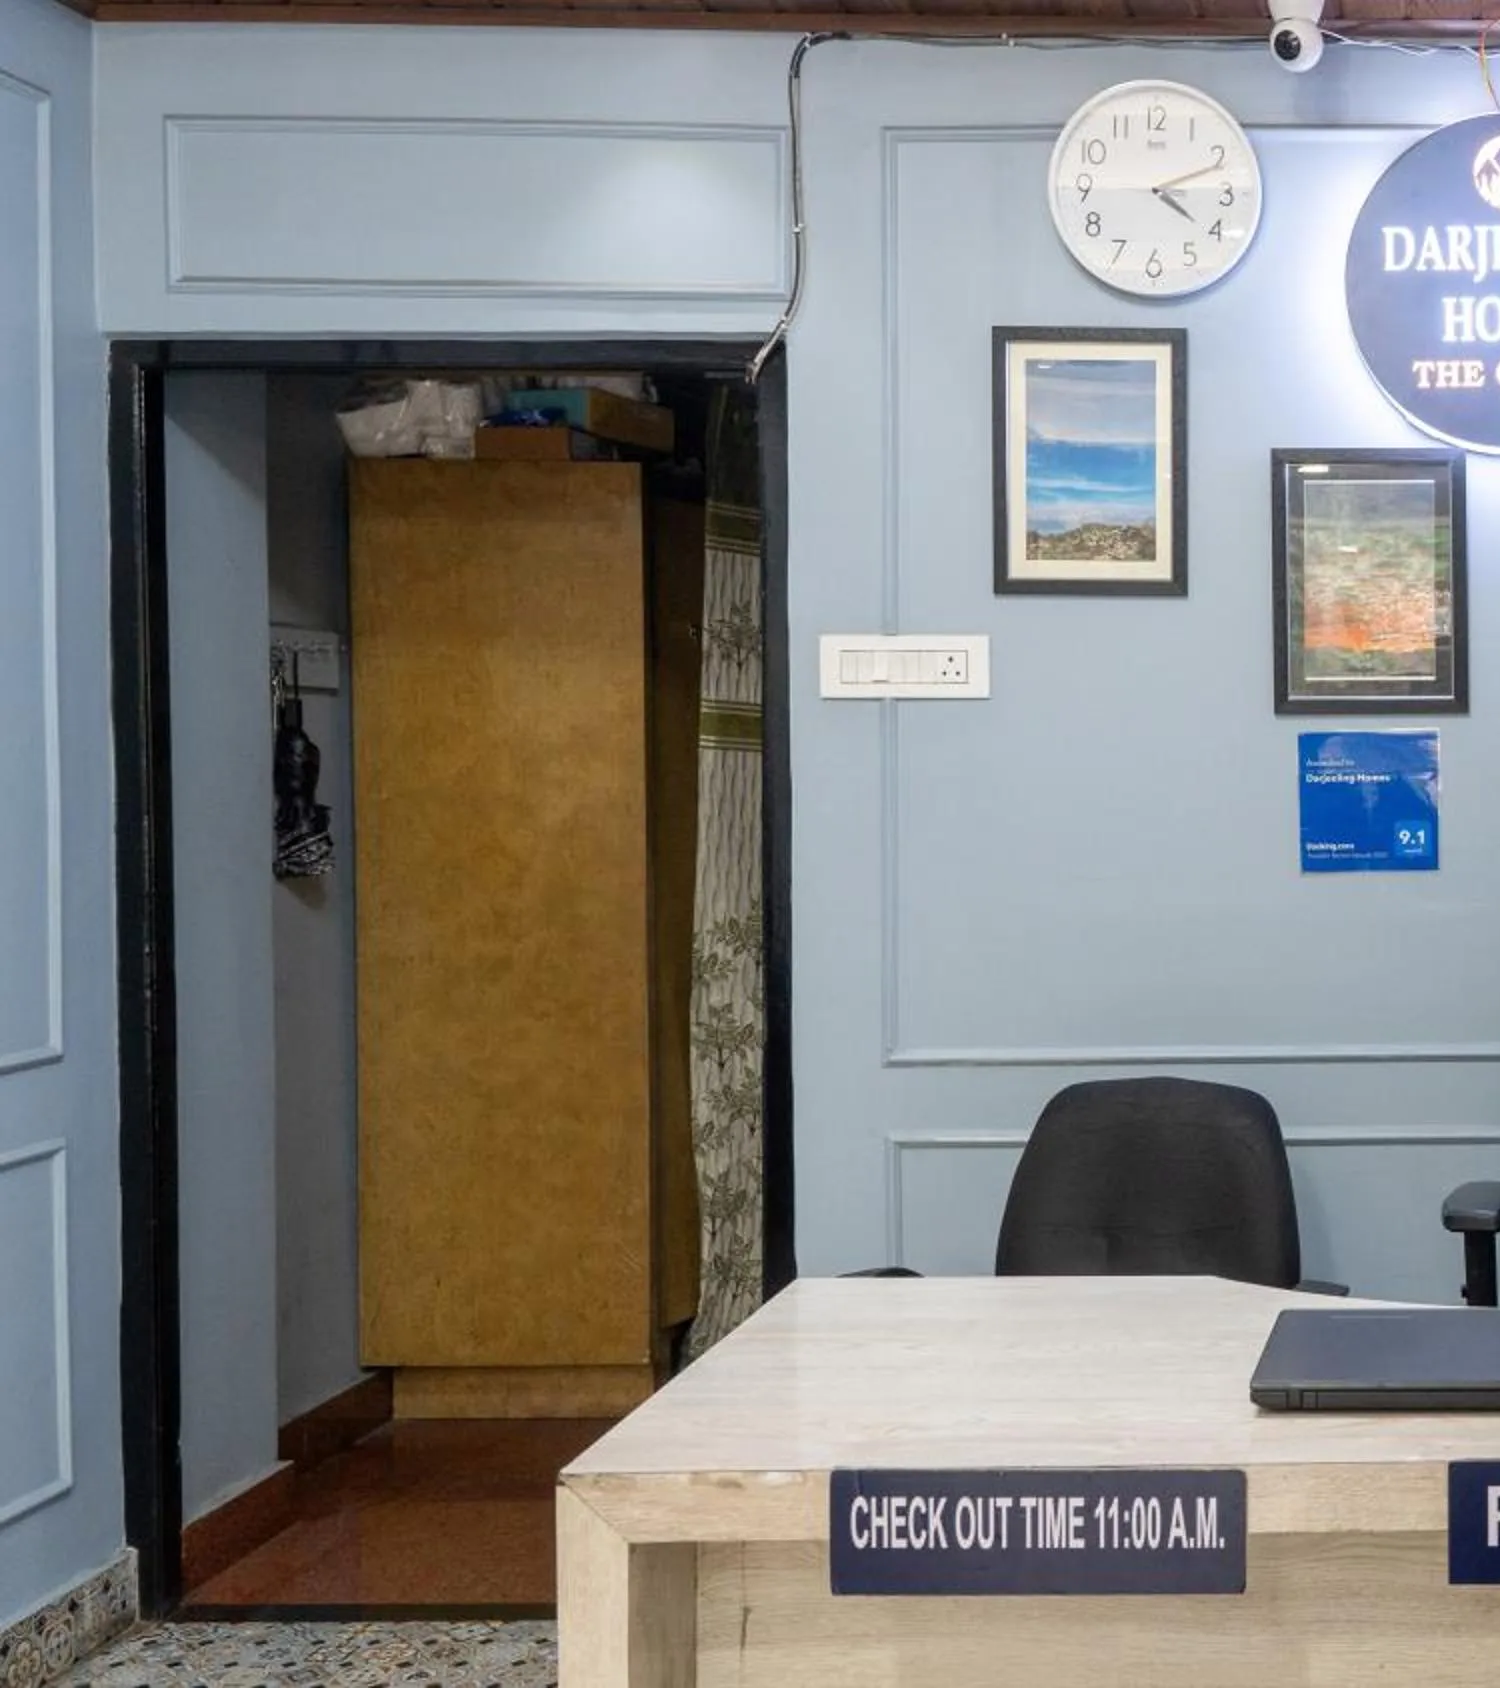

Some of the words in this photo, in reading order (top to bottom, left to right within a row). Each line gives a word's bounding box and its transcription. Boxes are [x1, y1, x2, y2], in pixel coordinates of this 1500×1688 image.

[1113, 114, 1129, 139] 11
[1147, 105, 1167, 131] 12
[1081, 138, 1107, 165] 10
[1210, 145, 1226, 169] 2
[1076, 173, 1093, 203] 9
[1219, 181, 1235, 207] 3
[1085, 211, 1102, 237] 8
[1208, 219, 1222, 242] 4
[1111, 239, 1128, 265] 7
[1145, 248, 1163, 279] 6
[1183, 242, 1197, 268] 5
[1412, 360, 1486, 389] THE
[1306, 773, 1355, 785] Darjeeling
[1357, 773, 1392, 783] Homes
[1399, 828, 1426, 846] 9.1
[850, 1495, 948, 1549] CHECK
[955, 1495, 1012, 1549] OUT
[1020, 1496, 1086, 1549] TIME
[1094, 1496, 1162, 1549] 11:00
[1168, 1496, 1226, 1549] A.M.
